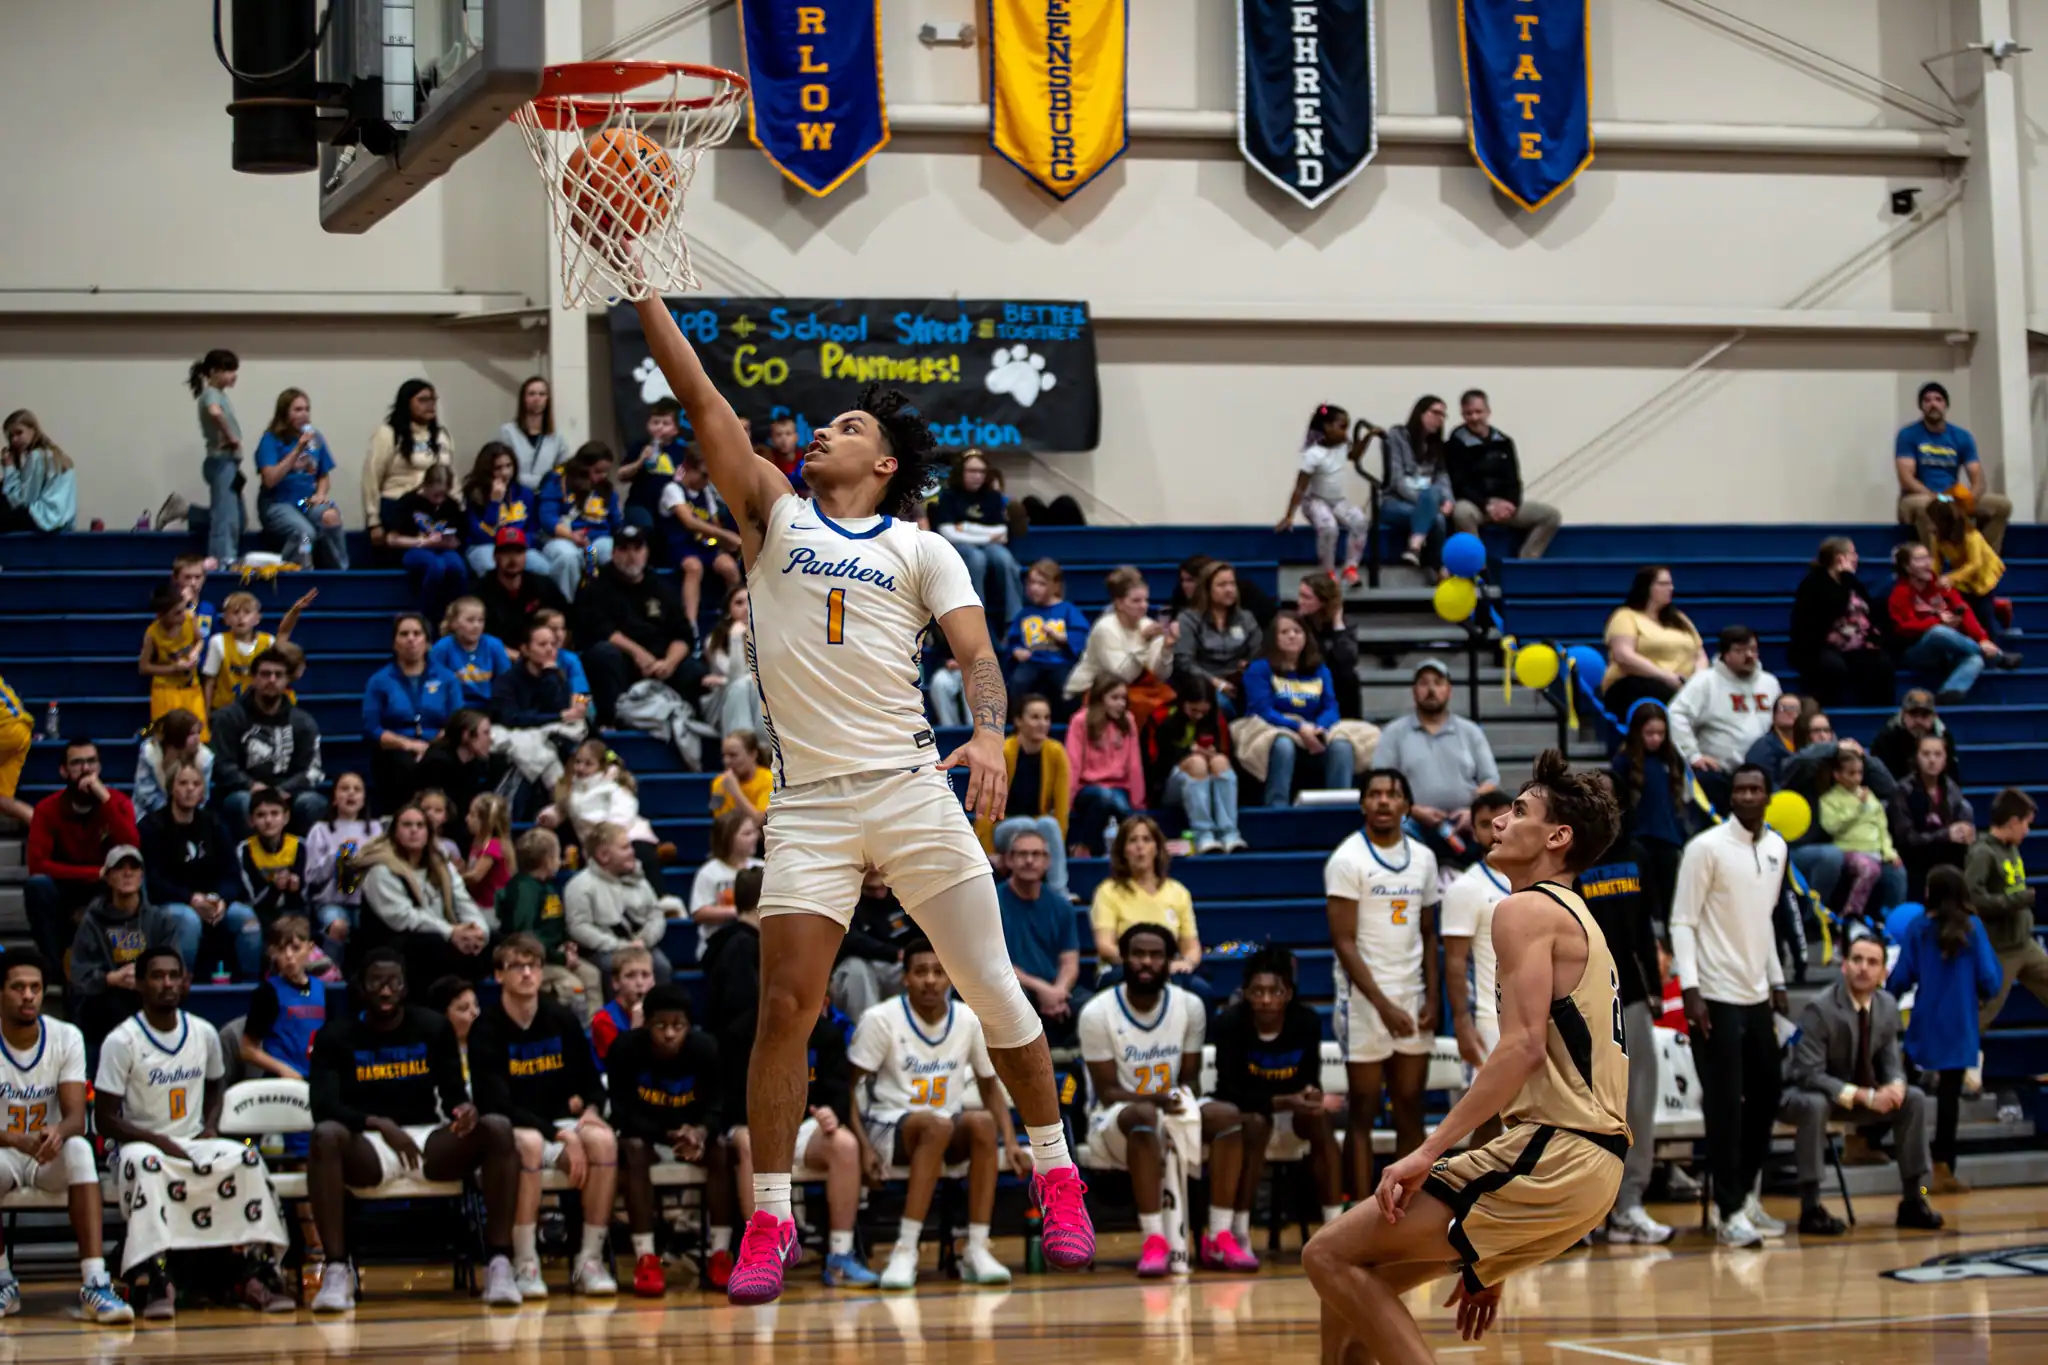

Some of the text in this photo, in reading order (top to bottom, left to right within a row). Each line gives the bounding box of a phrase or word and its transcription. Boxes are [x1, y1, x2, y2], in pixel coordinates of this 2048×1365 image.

[1291, 0, 1325, 188] EHREND
[1513, 0, 1543, 160] TATE
[769, 307, 868, 343] School
[893, 311, 973, 345] Street
[1003, 302, 1088, 326] BETTER
[996, 323, 1082, 341] TOGETHER
[782, 547, 897, 592] Panthers
[826, 587, 846, 645] 1
[1391, 899, 1409, 925] 2
[901, 1056, 959, 1074] Panthers
[1124, 1044, 1181, 1063] Panthers
[149, 1065, 204, 1086] Panthers
[355, 1058, 430, 1082] BASKETBALL
[1134, 1063, 1172, 1095] 23
[0, 1081, 58, 1102] Panthers
[169, 1087, 188, 1121] 0
[911, 1075, 948, 1108] 35
[8, 1101, 49, 1134] 32
